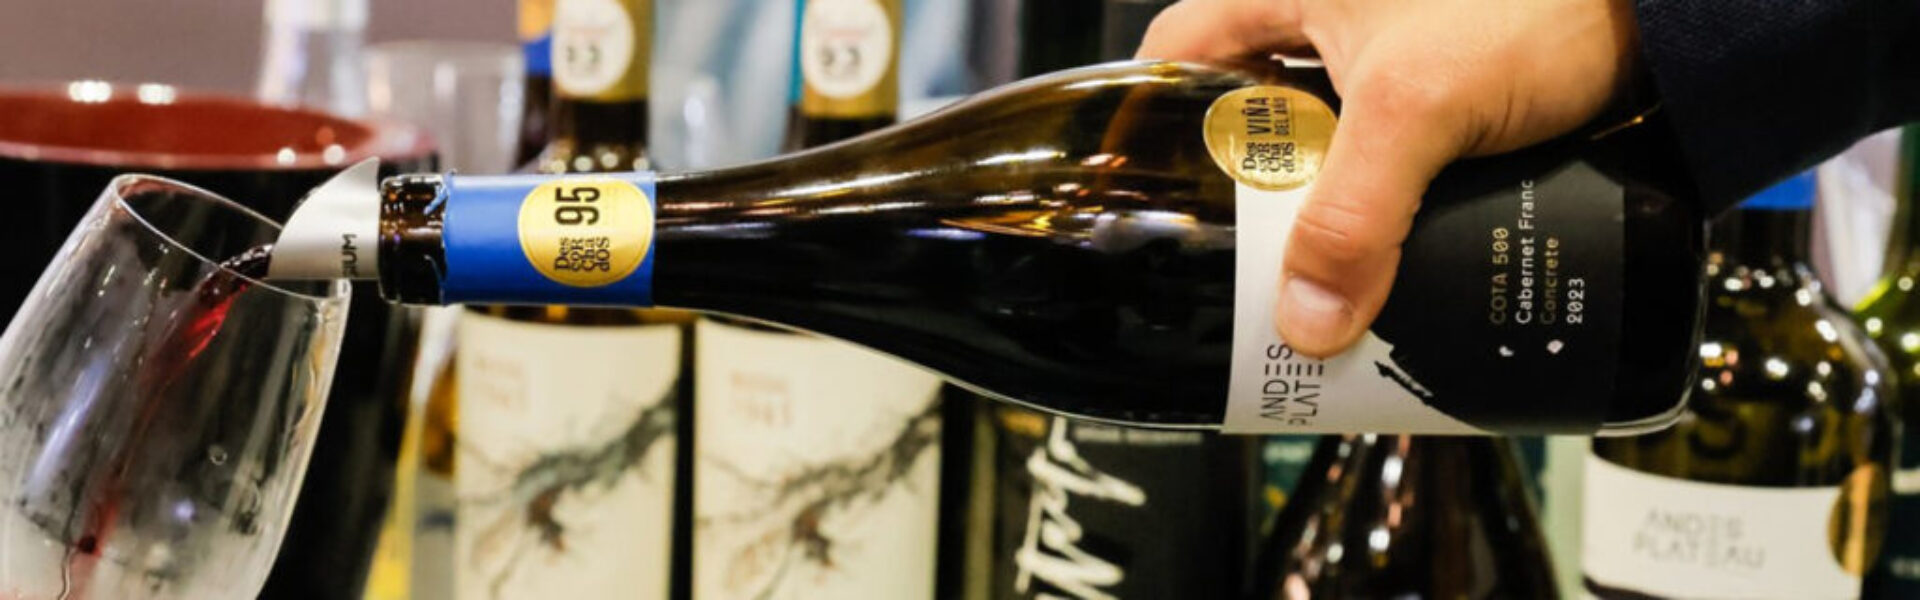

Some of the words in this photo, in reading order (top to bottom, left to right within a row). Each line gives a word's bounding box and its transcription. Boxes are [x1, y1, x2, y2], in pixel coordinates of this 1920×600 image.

[1242, 98, 1271, 135] VIÑA
[1274, 119, 1290, 135] DEL
[554, 187, 601, 226] 95
[1518, 179, 1536, 230] Franc
[554, 237, 570, 271] Des
[1492, 227, 1509, 265] 500
[1489, 272, 1508, 325] COTA
[1515, 236, 1536, 324] Cabernet
[1540, 236, 1560, 325] Concrete
[1566, 277, 1585, 324] 2023
[1259, 343, 1293, 421] ANDES
[1288, 362, 1324, 426] PLATE
